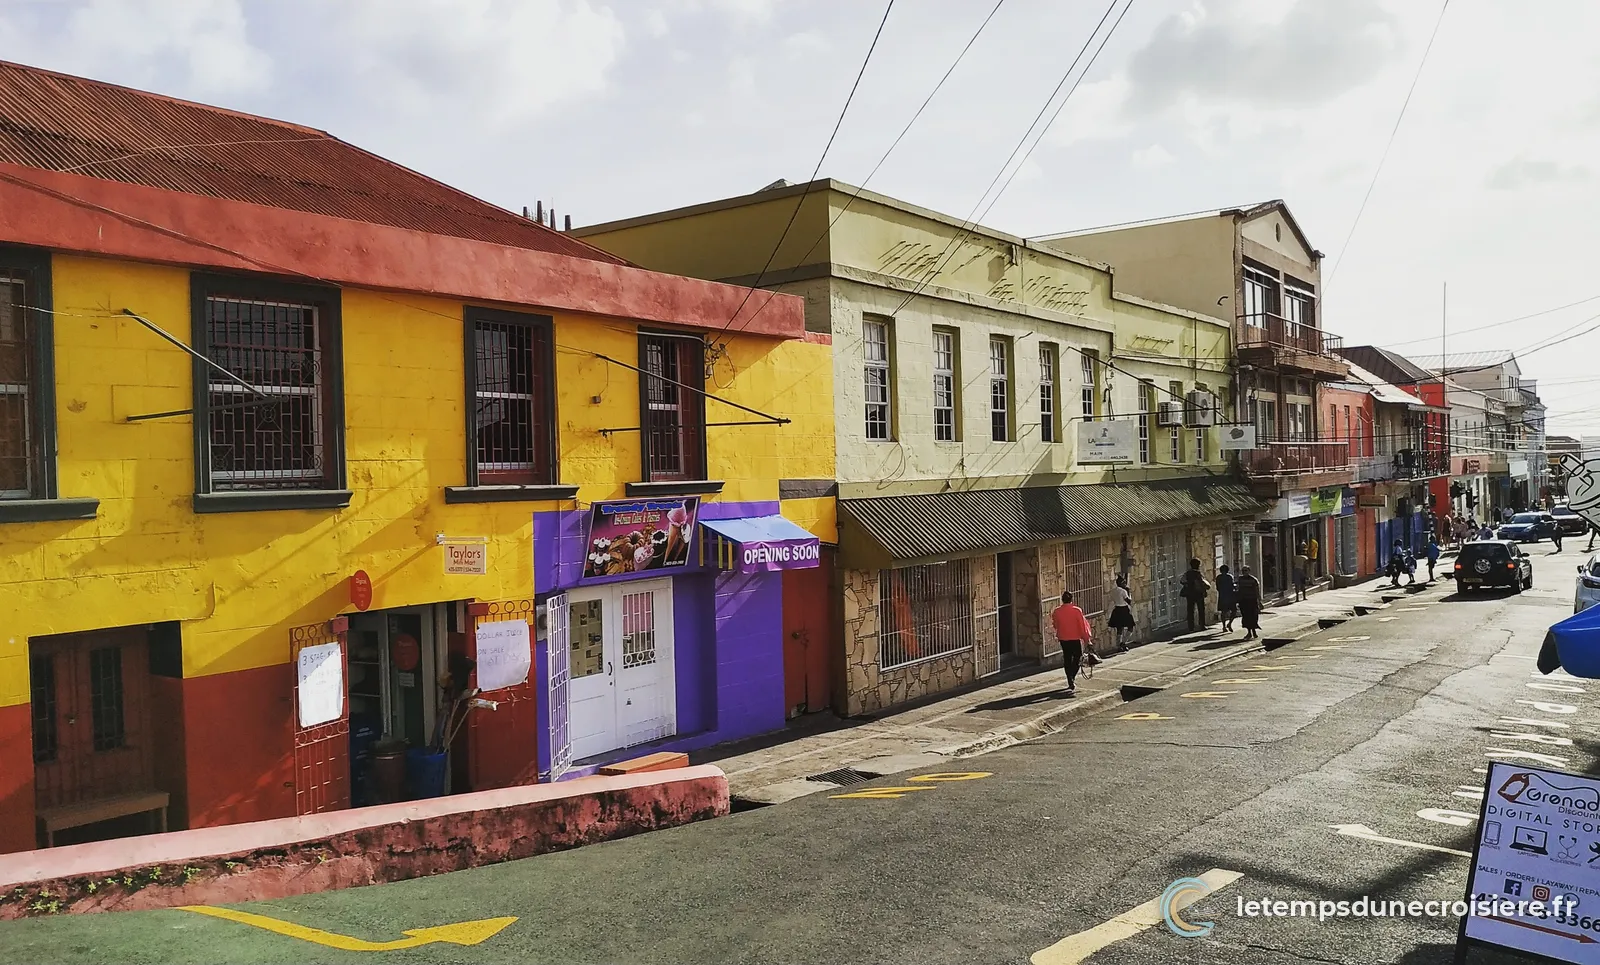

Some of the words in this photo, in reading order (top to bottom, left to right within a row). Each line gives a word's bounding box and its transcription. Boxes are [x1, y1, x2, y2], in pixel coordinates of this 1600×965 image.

[448, 545, 481, 560] Taylor's
[743, 547, 790, 565] OPENING
[792, 545, 819, 561] SOON
[477, 632, 503, 641] DOLLAR
[490, 646, 505, 654] SALE
[1488, 805, 1553, 827] DIGITAL
[1478, 864, 1498, 875] SALES
[1505, 871, 1535, 883] ORDERS
[1541, 878, 1574, 891] LAYAWAY
